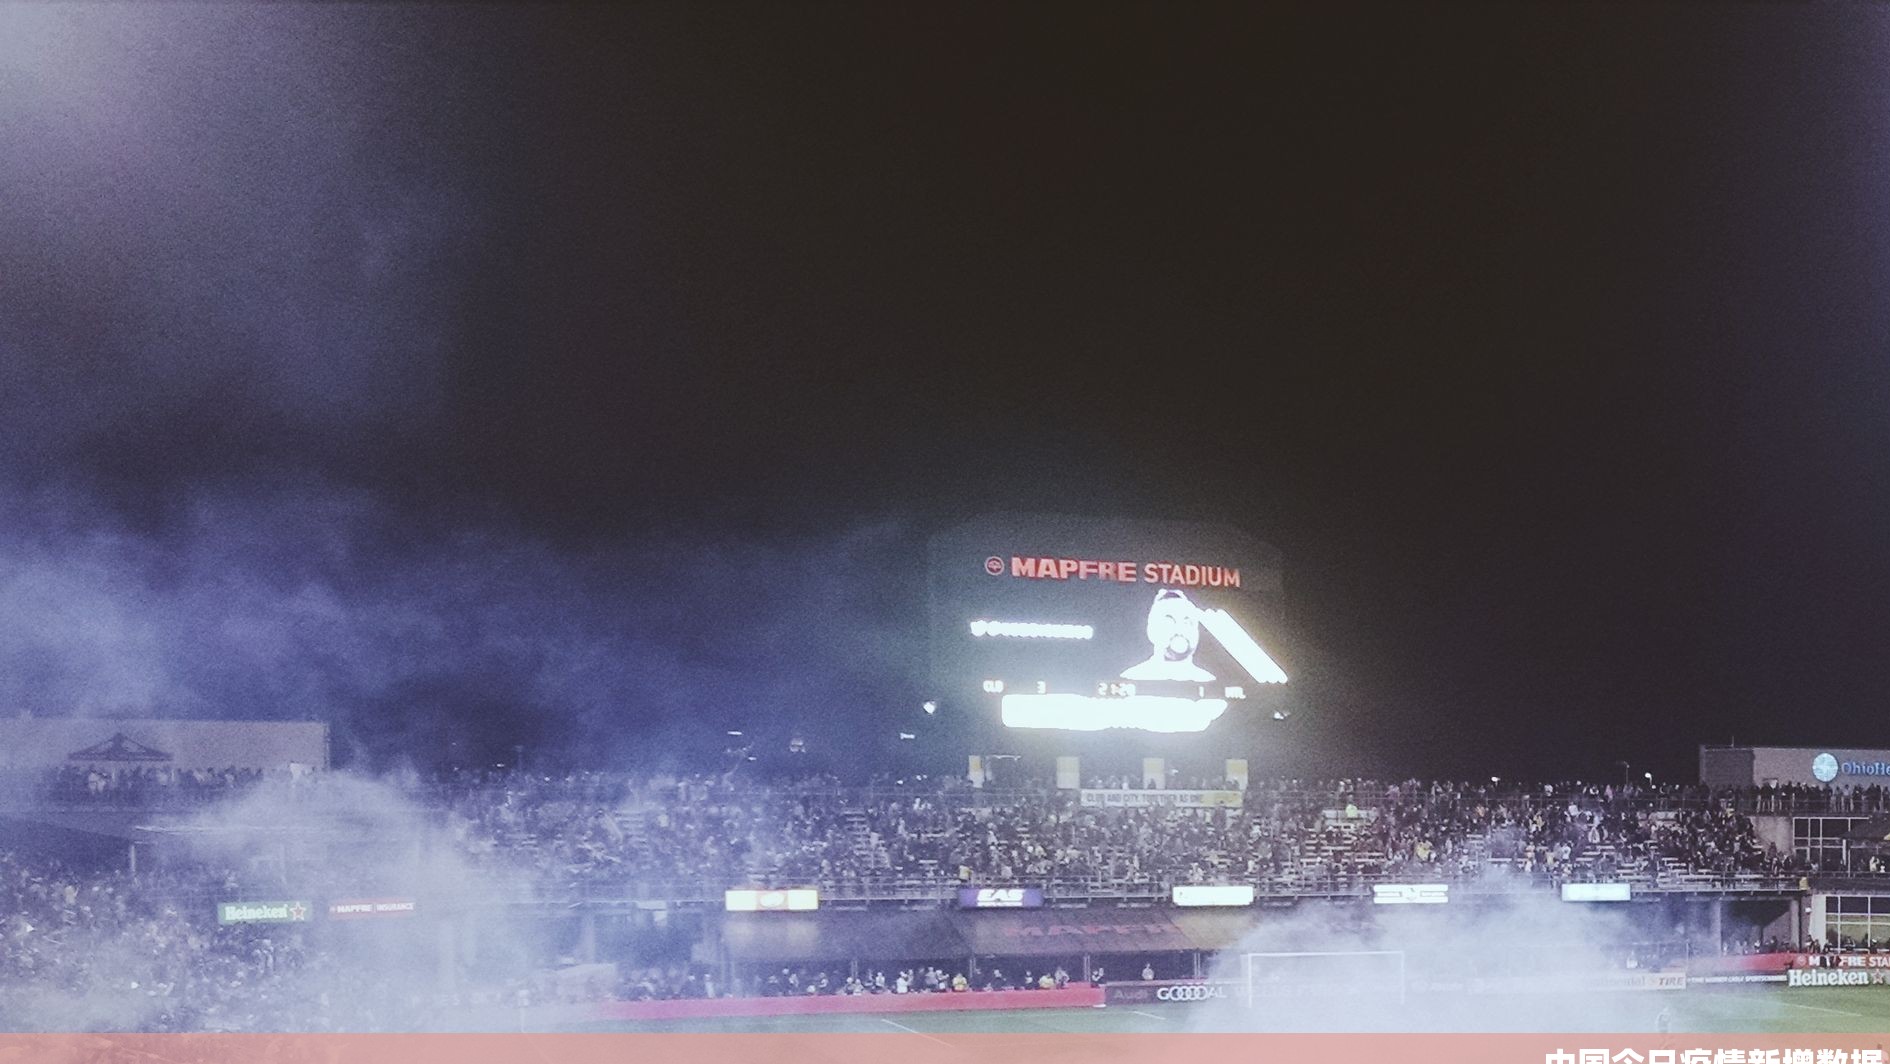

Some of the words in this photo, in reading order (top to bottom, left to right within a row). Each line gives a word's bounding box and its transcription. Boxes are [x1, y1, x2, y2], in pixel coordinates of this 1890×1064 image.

[1011, 557, 1137, 582] MAPFRE
[1144, 563, 1241, 588] STADIUM
[224, 904, 288, 921] Heineken
[337, 904, 373, 913] MAPFRE
[1808, 955, 1866, 967] MFRE
[1659, 977, 1685, 986] TIRE
[1788, 969, 1869, 987] Heineken
